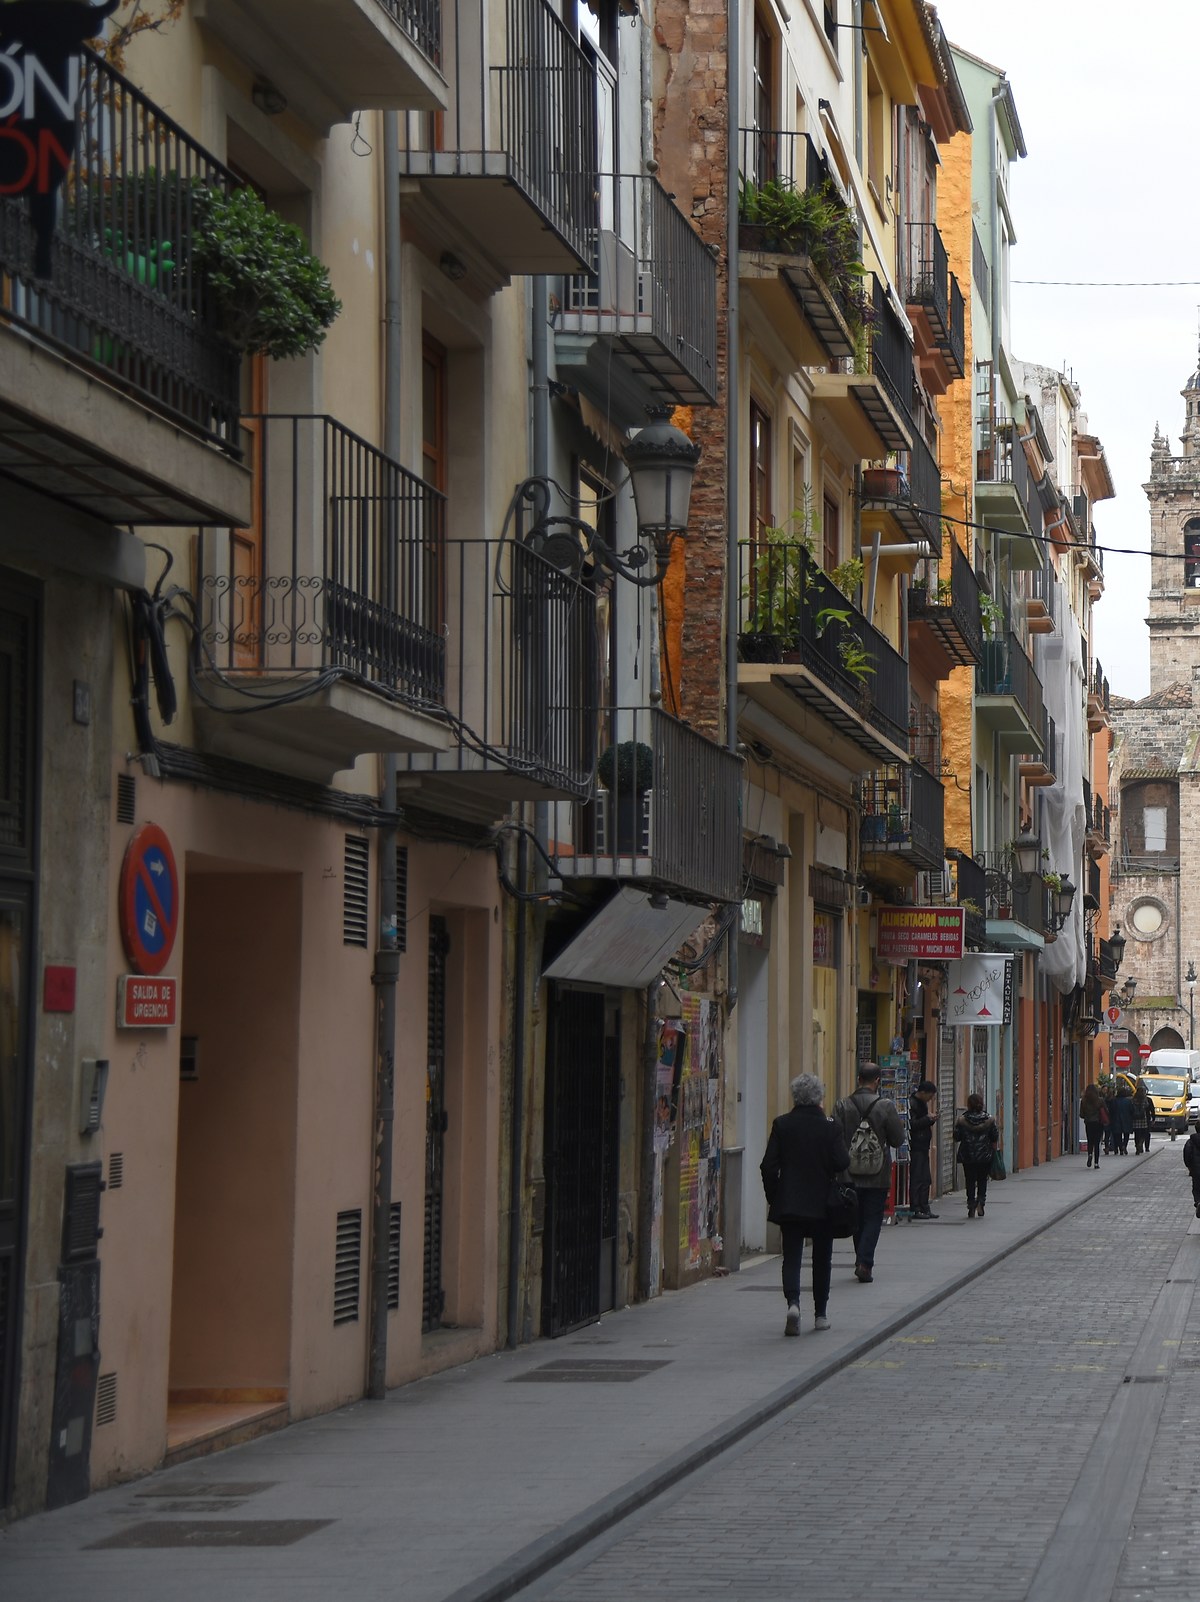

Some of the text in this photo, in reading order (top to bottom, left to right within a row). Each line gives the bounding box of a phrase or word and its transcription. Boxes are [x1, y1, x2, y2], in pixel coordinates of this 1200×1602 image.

[880, 912, 936, 928] ALIMENTACION
[898, 932, 909, 941] SECO
[911, 932, 938, 941] CARAMELOS
[940, 933, 959, 941] BEBIDAS
[921, 945, 924, 953] Y
[926, 945, 943, 953] MUCHO
[132, 985, 171, 1000] SALIDA DE
[966, 968, 1002, 1002] ROCHE
[1004, 961, 1012, 1024] RESTAURANTE
[134, 1003, 168, 1018] URGENCIA
